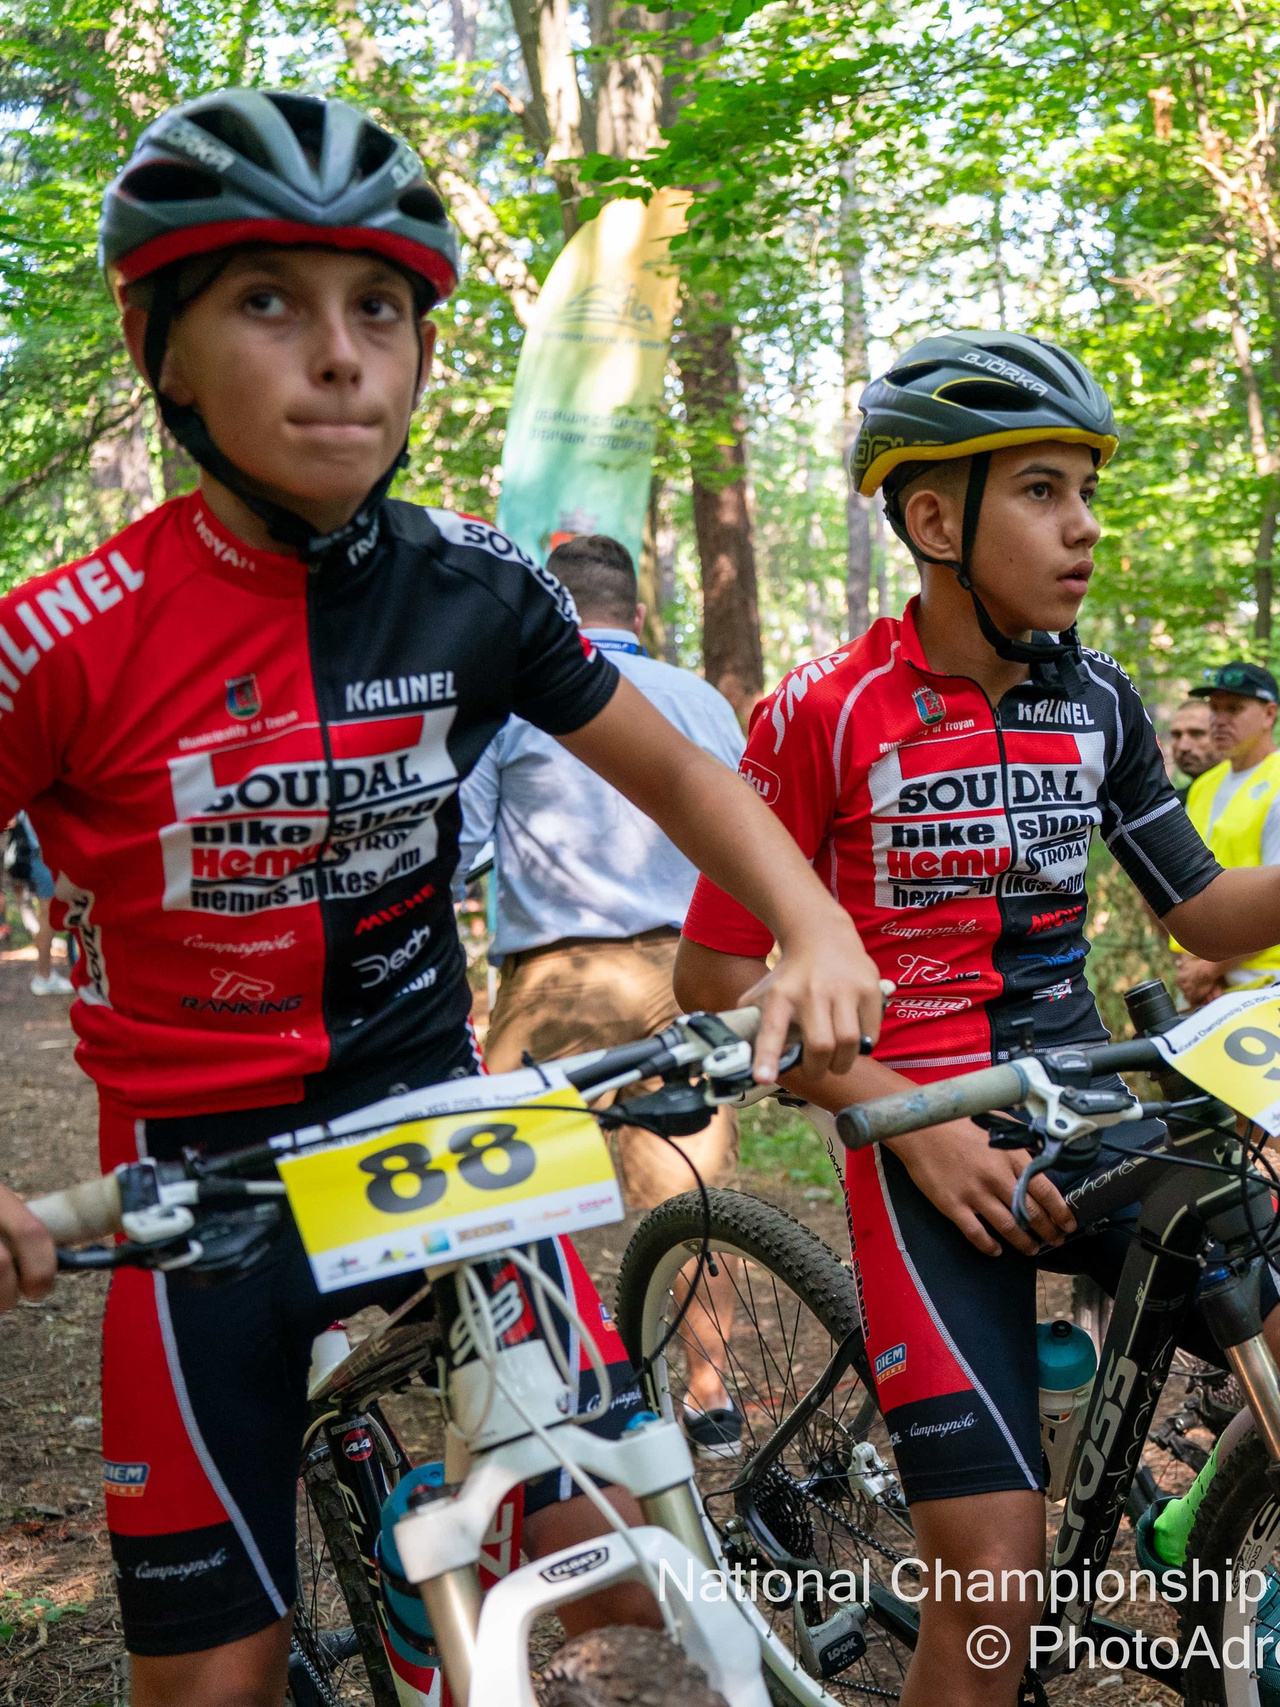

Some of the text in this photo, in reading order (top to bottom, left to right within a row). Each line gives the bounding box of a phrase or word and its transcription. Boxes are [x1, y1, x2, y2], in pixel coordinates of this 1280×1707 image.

[959, 352, 1048, 397] BJÖRKA
[345, 671, 458, 713] KALINEL
[945, 717, 976, 731] Troyan
[1017, 698, 1095, 727] KALINEL
[899, 770, 1083, 815] SOUDAL
[191, 822, 312, 846] bike
[891, 813, 1096, 848] bike shop
[880, 918, 984, 941] Campagnolo
[358, 1123, 537, 1215] 88
[876, 1346, 906, 1373] DIEM
[905, 1411, 979, 1439] Campagnolo
[345, 1437, 372, 1454] 44
[826, 1636, 858, 1662] LOOK
